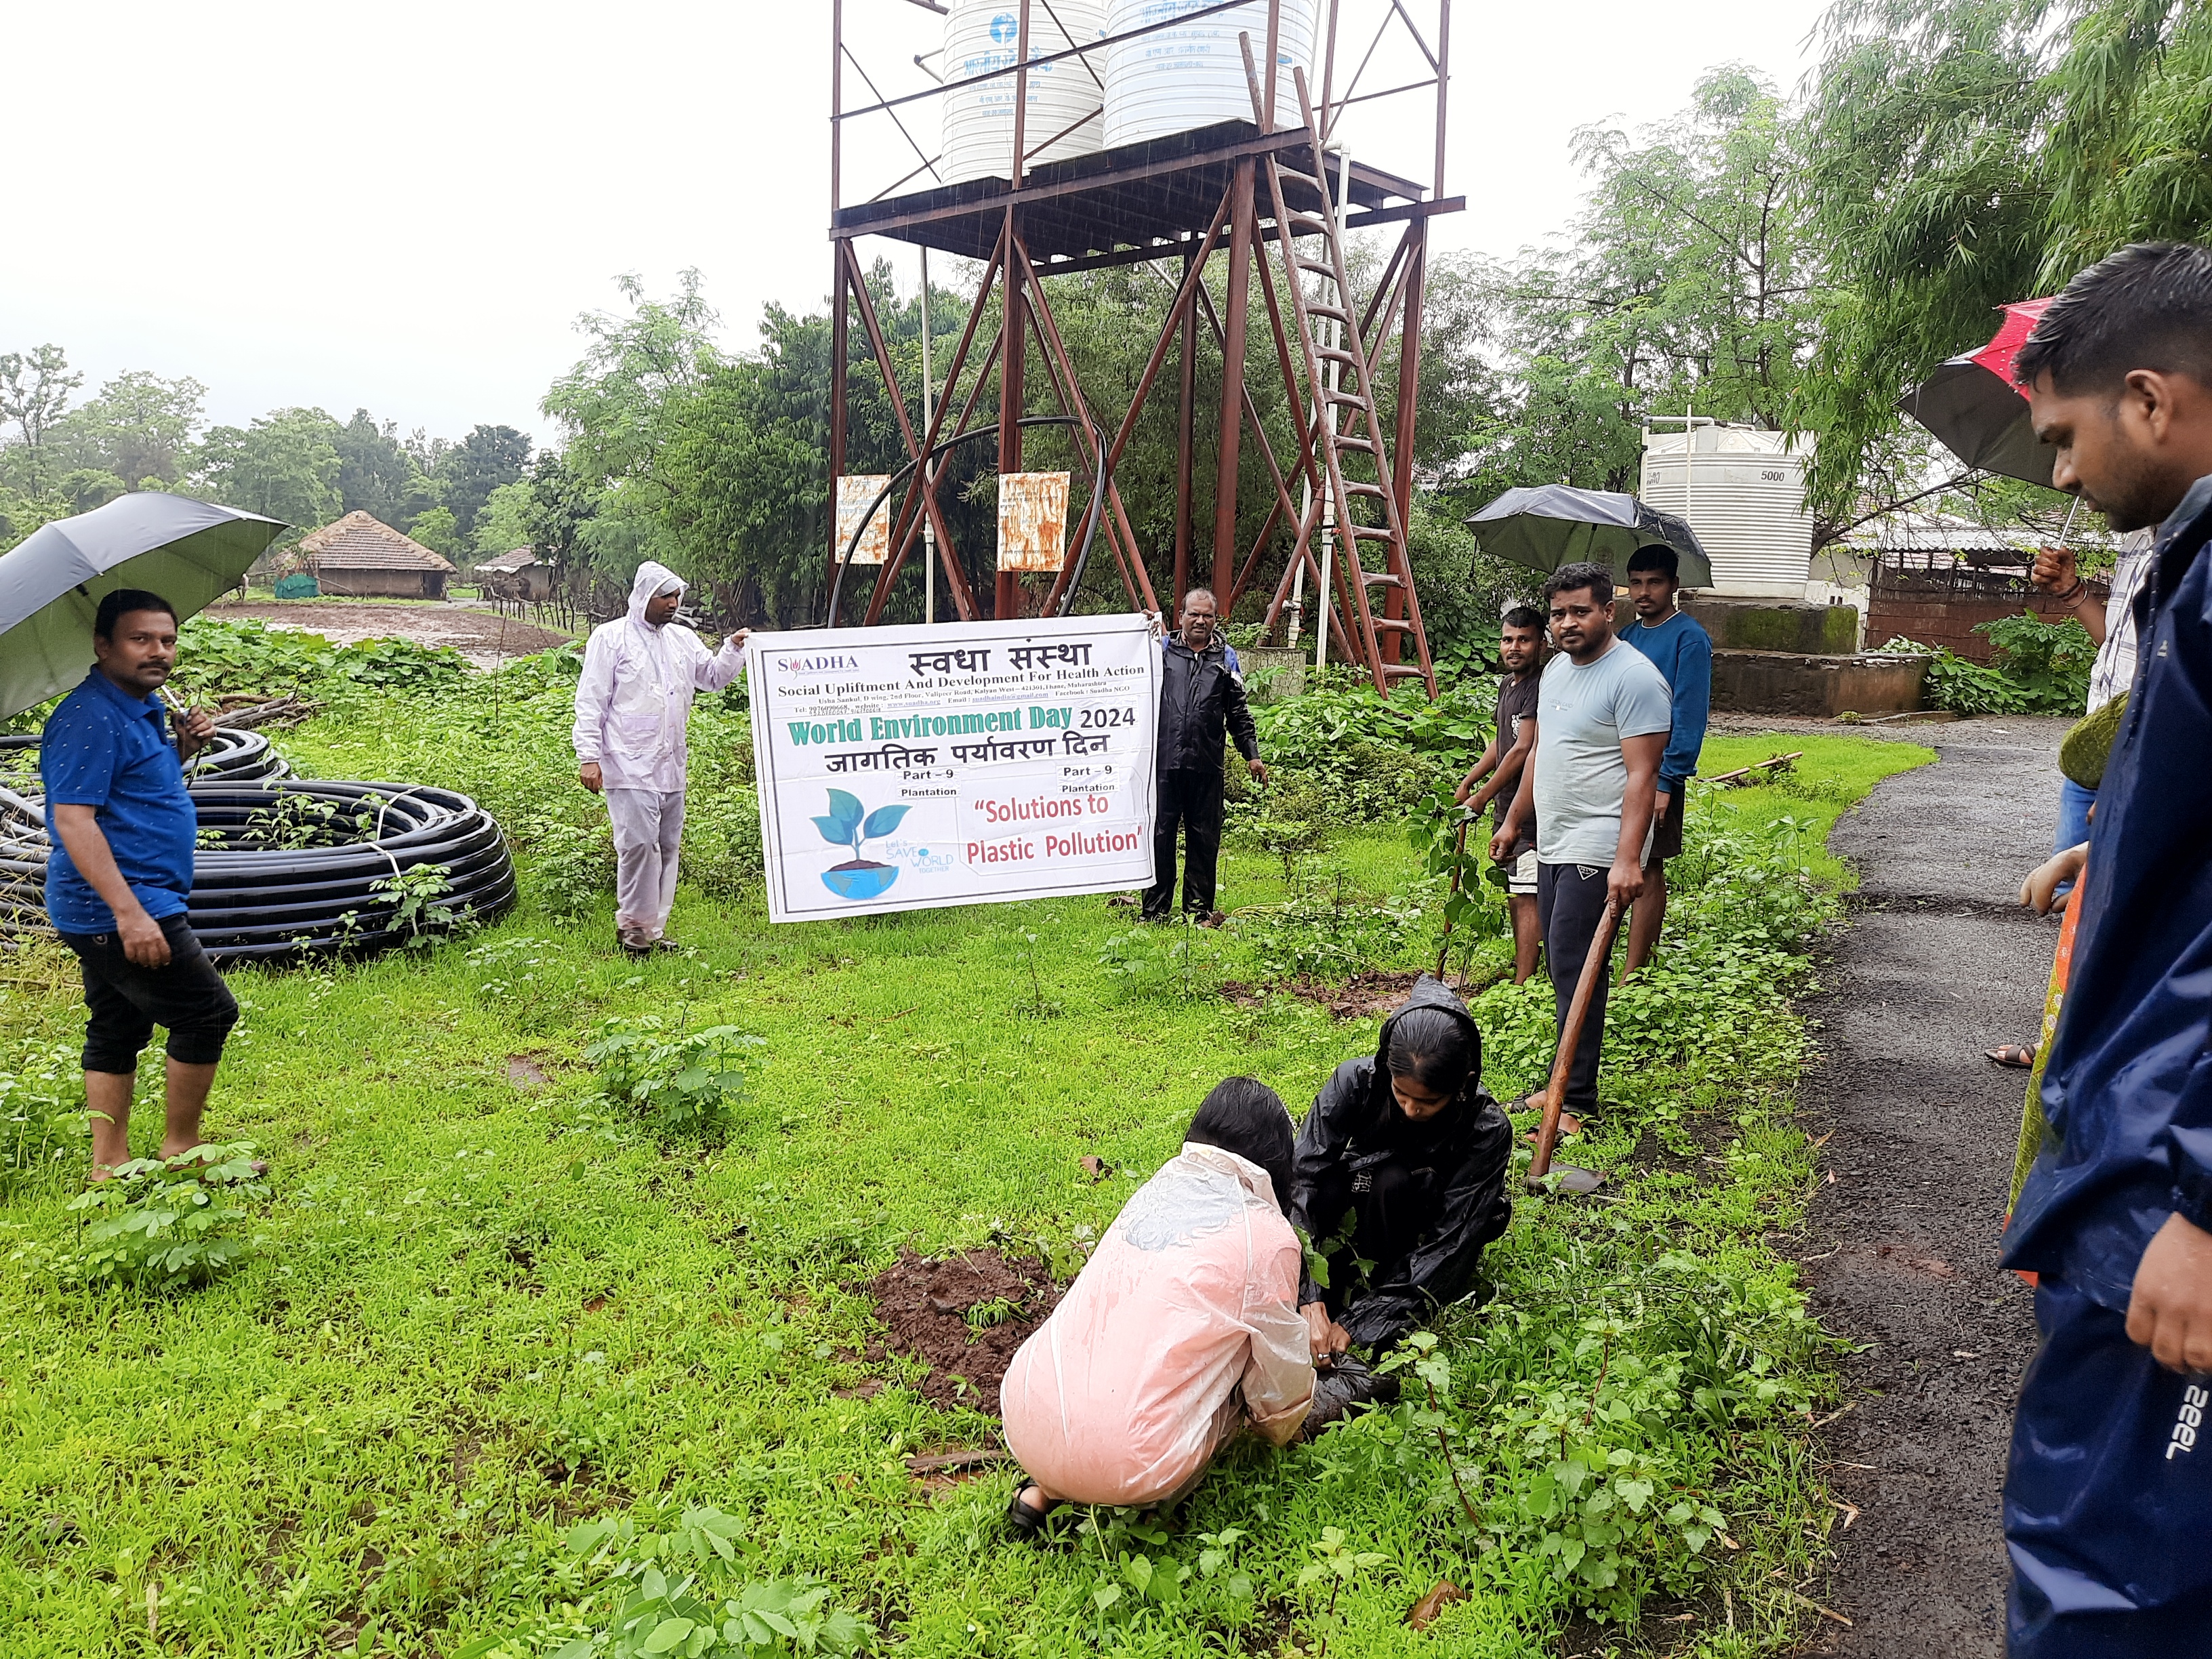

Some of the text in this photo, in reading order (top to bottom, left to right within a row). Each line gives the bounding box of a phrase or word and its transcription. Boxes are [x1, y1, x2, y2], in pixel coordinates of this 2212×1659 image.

[1761, 471, 1784, 481] 5000
[909, 638, 1092, 677] स्वधा संस्था
[778, 665, 1145, 697] Social Upliftment And Development For Health Action
[787, 705, 1135, 745] World Environment Day 2024
[824, 731, 1111, 772] जागतिक पर्यावरण दिन
[903, 770, 931, 779] Part
[945, 769, 954, 778] 9
[1064, 766, 1090, 776] Part
[1105, 765, 1113, 774] 9
[901, 787, 957, 797] Plantation
[1062, 784, 1115, 793] Plantation
[1088, 794, 1109, 814] to
[886, 846, 918, 859] SAVE
[967, 837, 1034, 864] Plastic
[910, 854, 954, 867] WORLD
